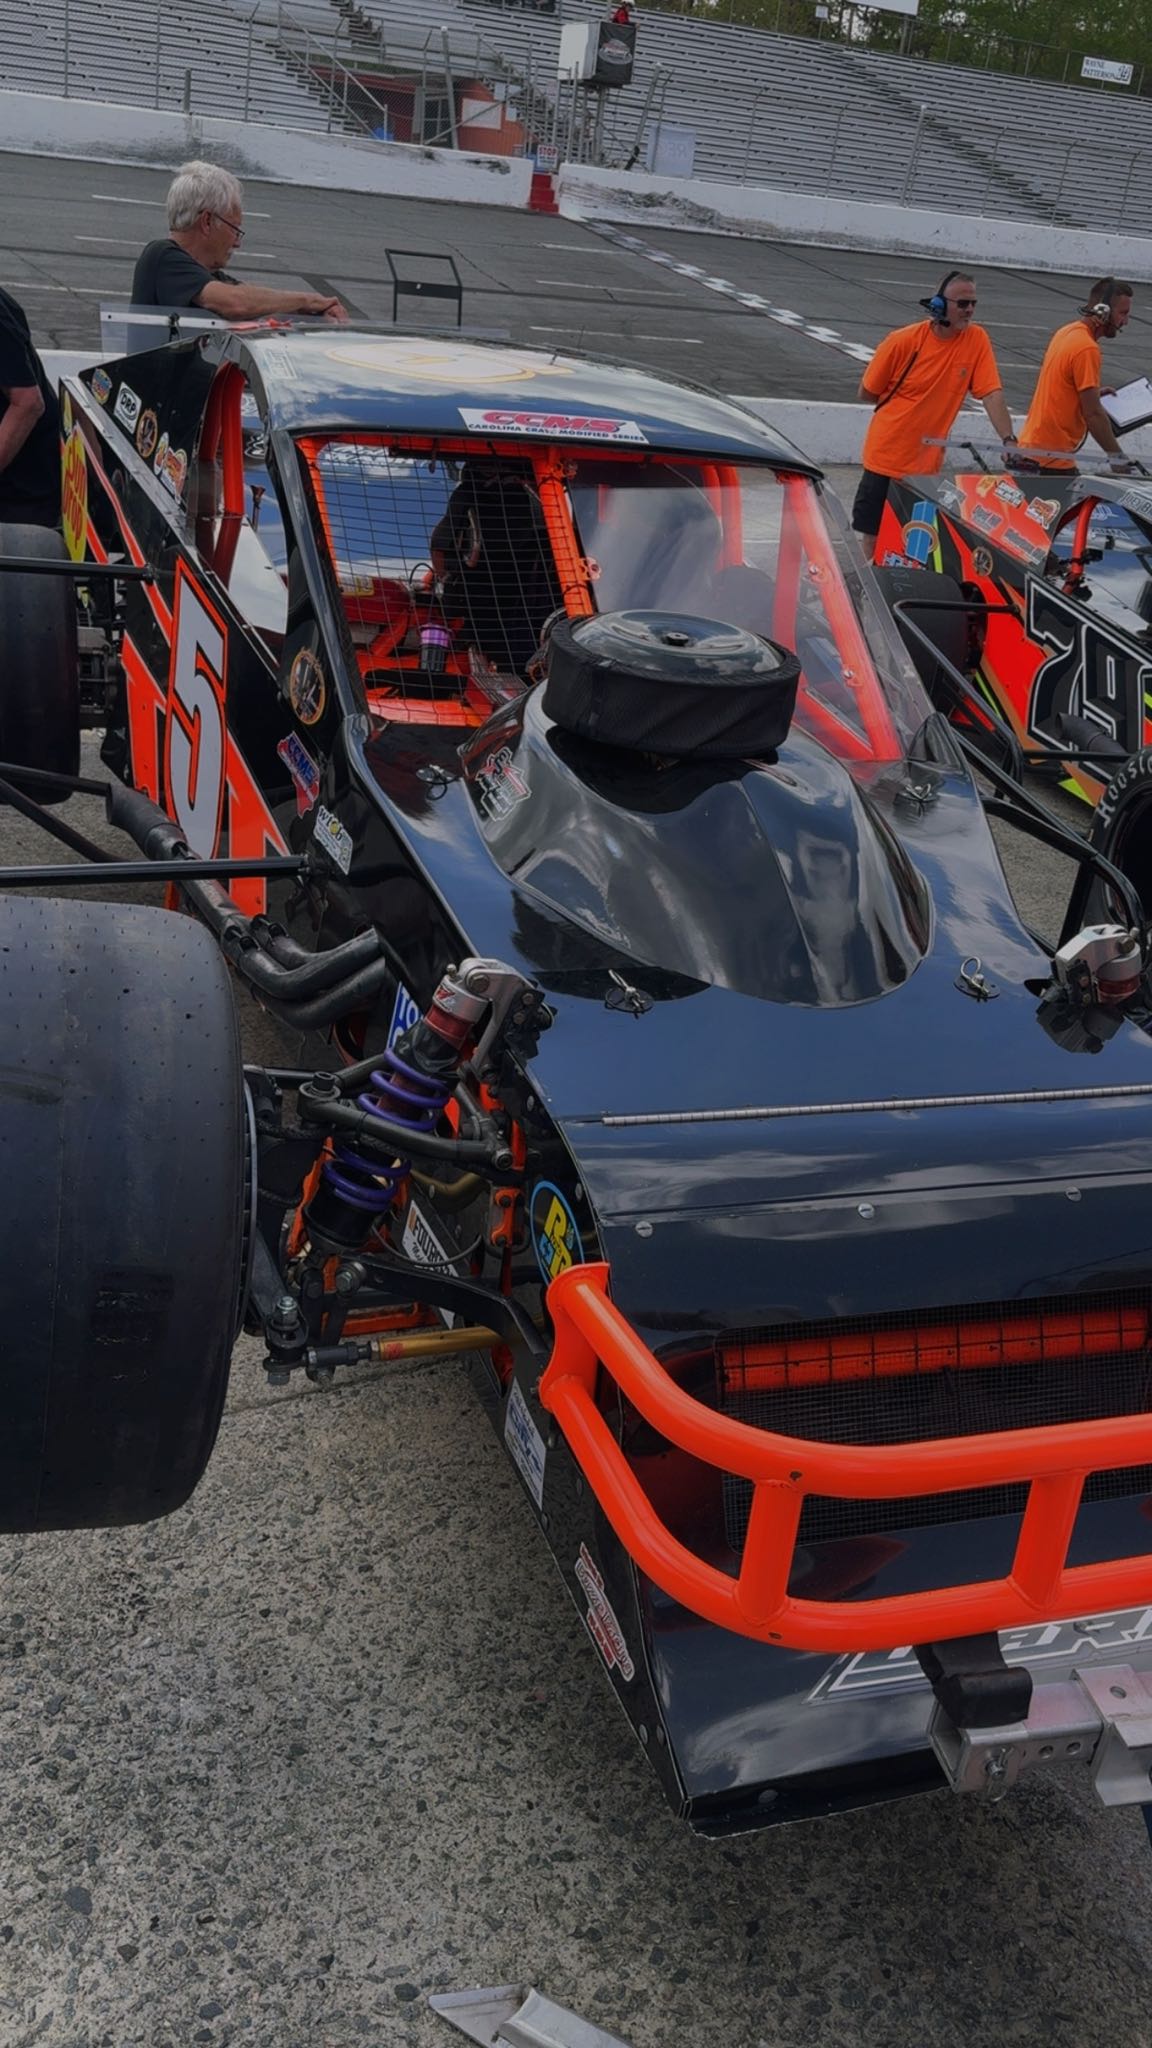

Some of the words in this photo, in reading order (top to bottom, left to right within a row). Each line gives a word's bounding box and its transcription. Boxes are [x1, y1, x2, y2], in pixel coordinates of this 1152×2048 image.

[1083, 68, 1116, 80] PATTERSON
[538, 146, 557, 156] STOP
[120, 393, 137, 414] DRP
[468, 423, 522, 432] CAROLINA
[525, 427, 557, 435] CRA
[559, 430, 609, 438] MODIFIED
[612, 433, 646, 442] SERIES
[483, 411, 627, 433] CCMS
[163, 554, 229, 862] 5
[1095, 752, 1152, 829] HOOSI
